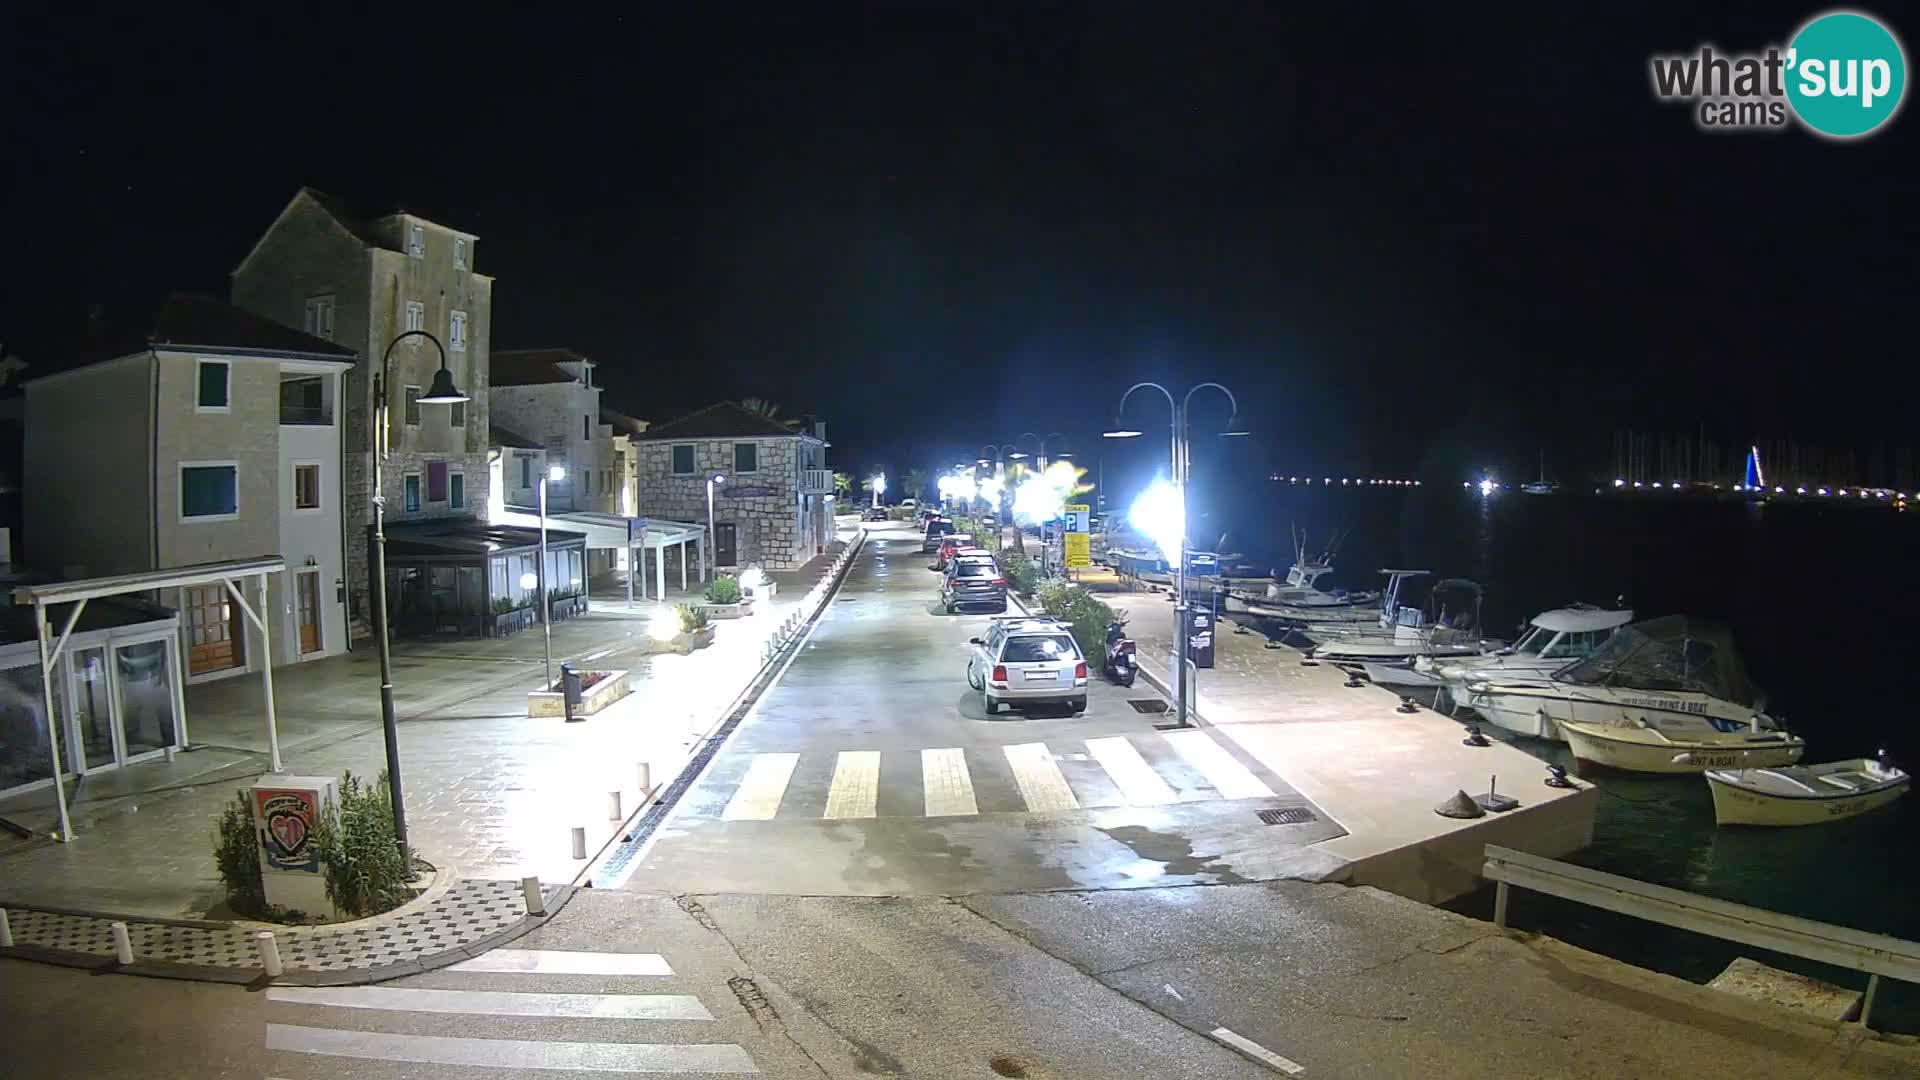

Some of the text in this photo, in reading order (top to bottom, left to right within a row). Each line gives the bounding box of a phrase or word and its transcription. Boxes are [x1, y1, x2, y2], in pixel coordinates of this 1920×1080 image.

[1066, 514, 1076, 531] P
[1658, 699, 1680, 709] RENT
[1687, 702, 1707, 714] BOAT
[1716, 756, 1736, 767] BOAT
